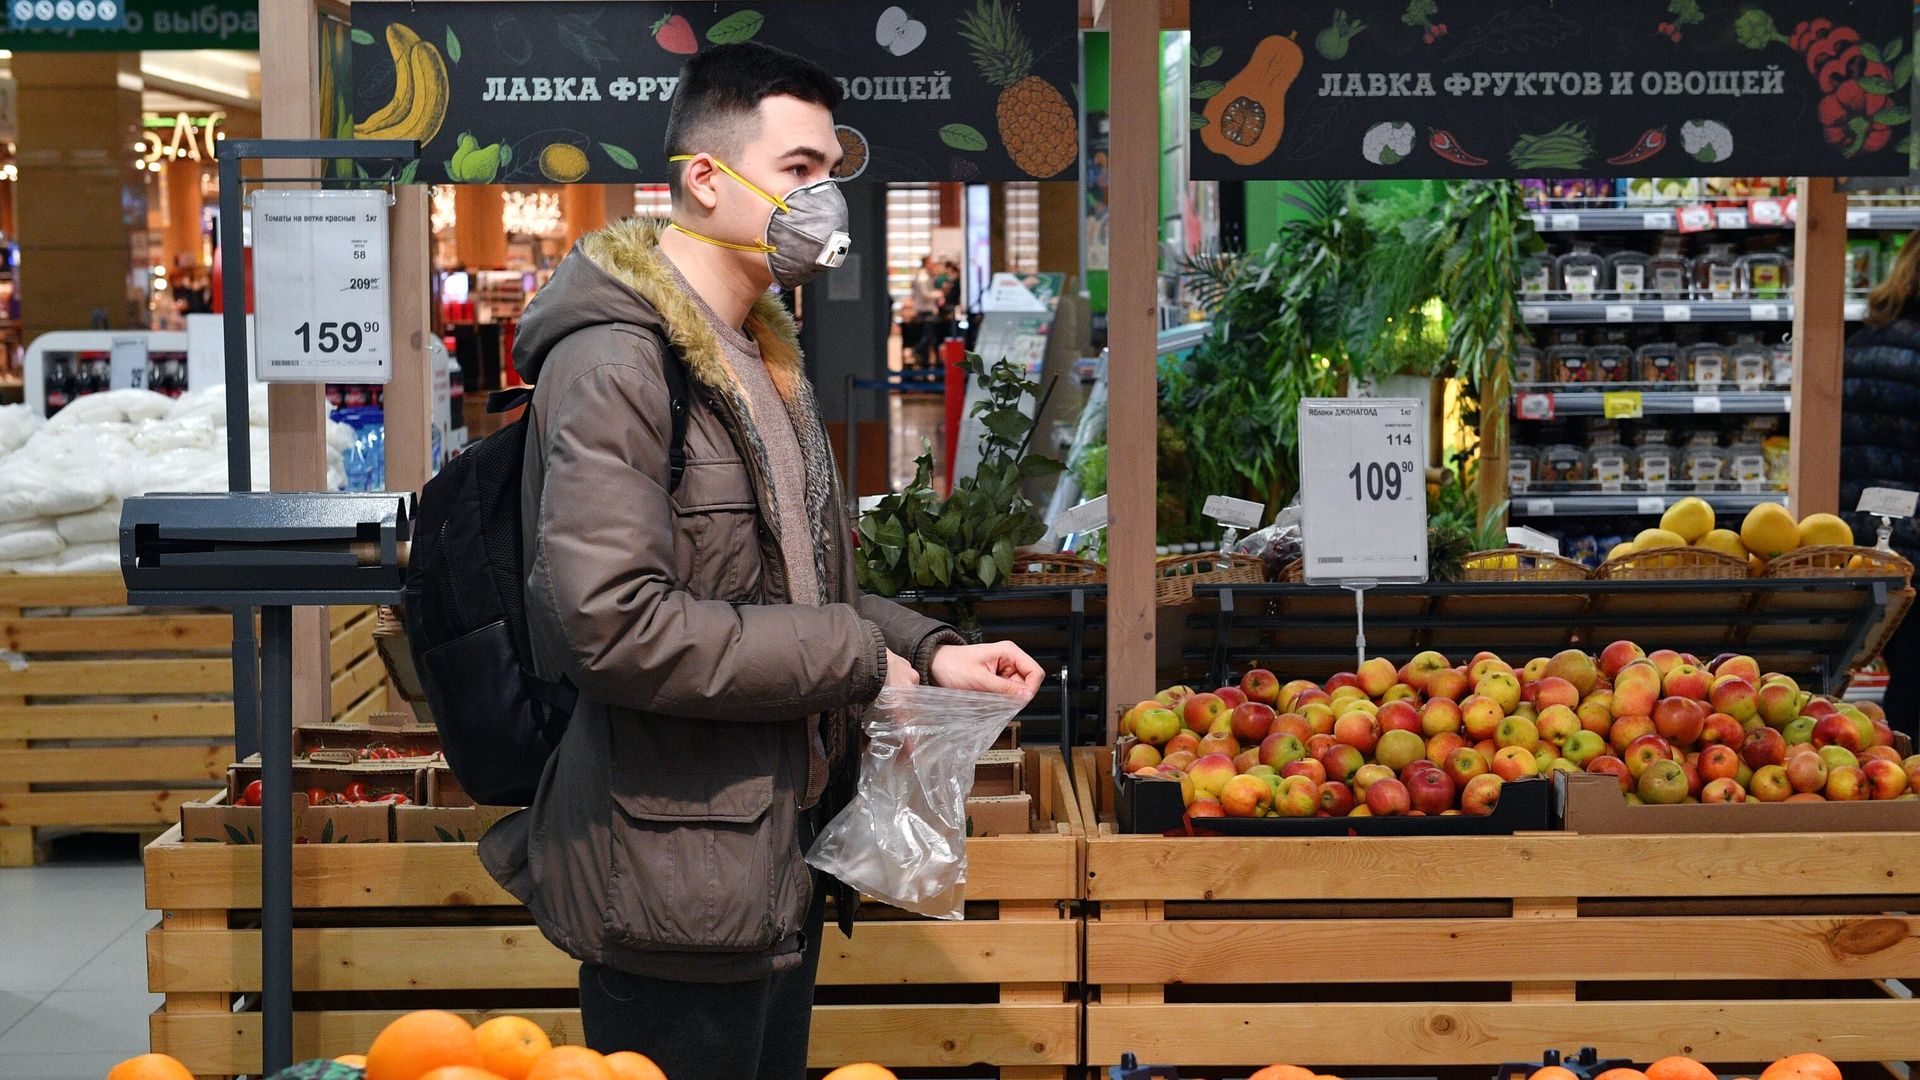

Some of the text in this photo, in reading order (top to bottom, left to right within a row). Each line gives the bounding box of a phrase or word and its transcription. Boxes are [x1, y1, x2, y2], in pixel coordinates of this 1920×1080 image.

[482, 76, 602, 102] ЛАВКА
[1318, 64, 1785, 98] ЛАВКА ФРУКТОВ И ОВОЩЕЙ
[264, 214, 292, 222] Томаты
[325, 215, 356, 223] красные
[350, 278, 371, 289] 209
[294, 321, 380, 354] 159 90
[1308, 408, 1333, 416] Яблоки
[1335, 408, 1378, 417] ДЖОНАГОЛД
[1386, 433, 1412, 446] 114
[1349, 460, 1414, 501] 109 90
